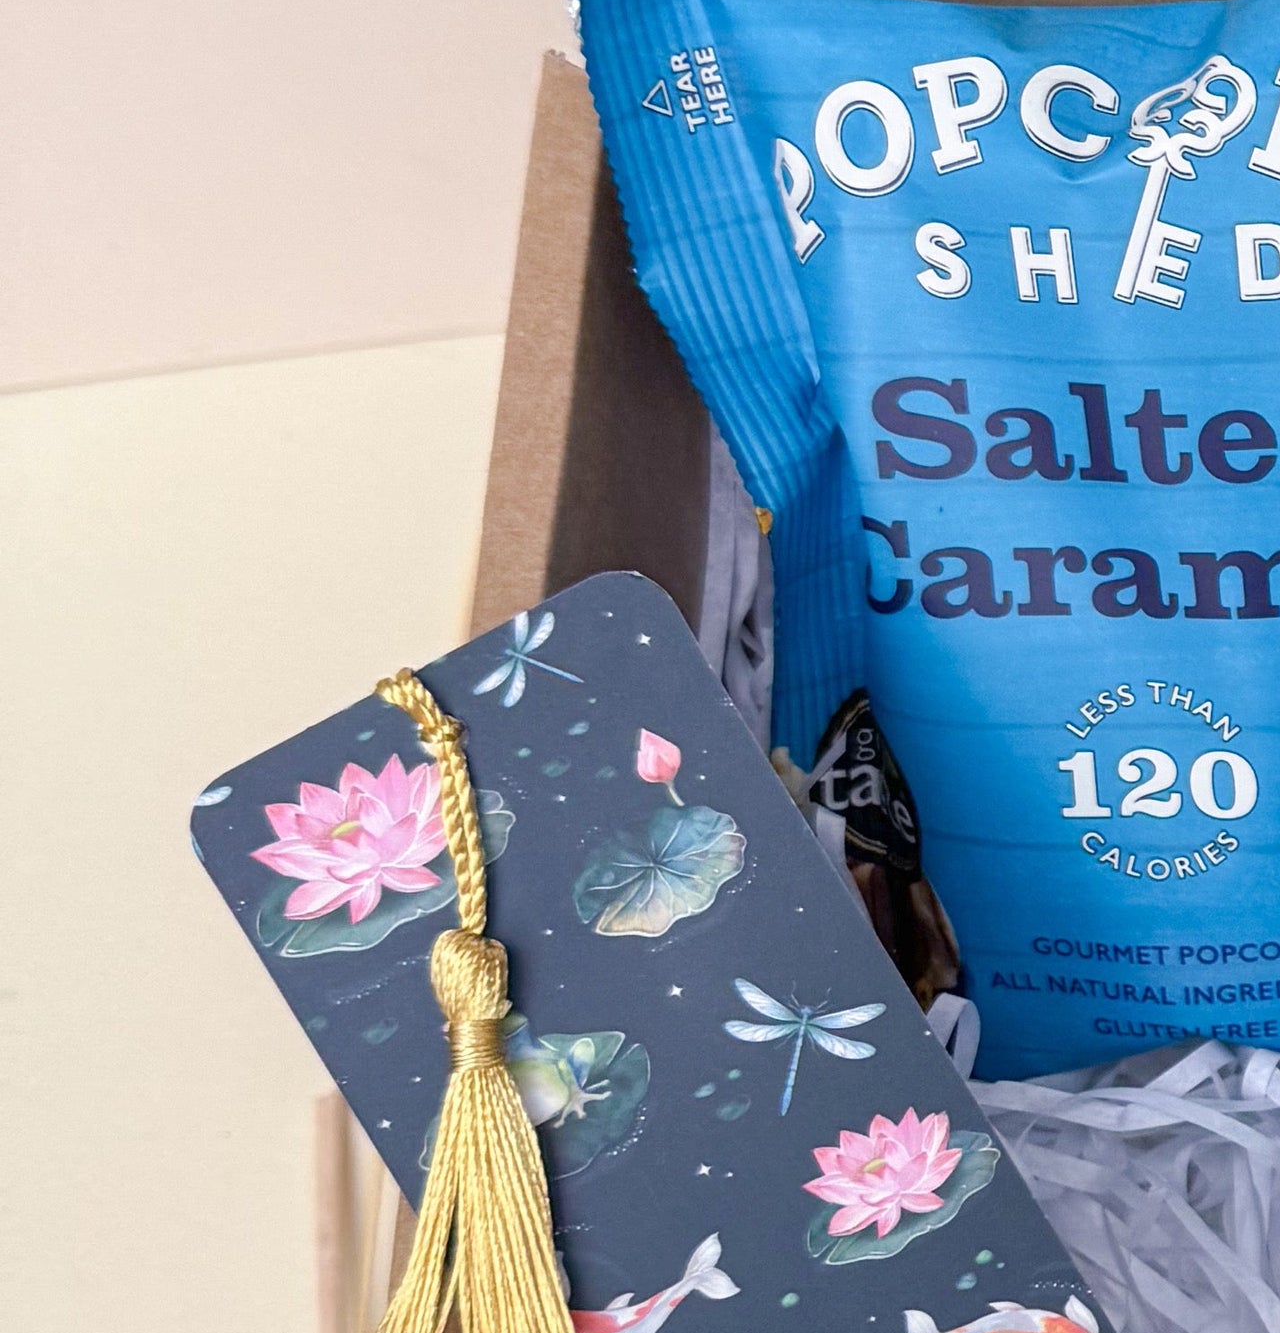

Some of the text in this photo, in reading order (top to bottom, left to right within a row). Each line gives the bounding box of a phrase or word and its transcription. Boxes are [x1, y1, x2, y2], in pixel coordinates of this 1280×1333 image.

[670, 51, 707, 133] TEAR
[694, 46, 734, 125] HERE
[1065, 680, 1242, 743] LESS THAN
[1057, 748, 1260, 820] 120
[1080, 830, 1239, 881] CALORIES
[1031, 936, 1170, 966] GOURMET
[992, 972, 1041, 992] ALL
[1048, 973, 1178, 1006] NATURAL
[1211, 1020, 1278, 1039] FREE
